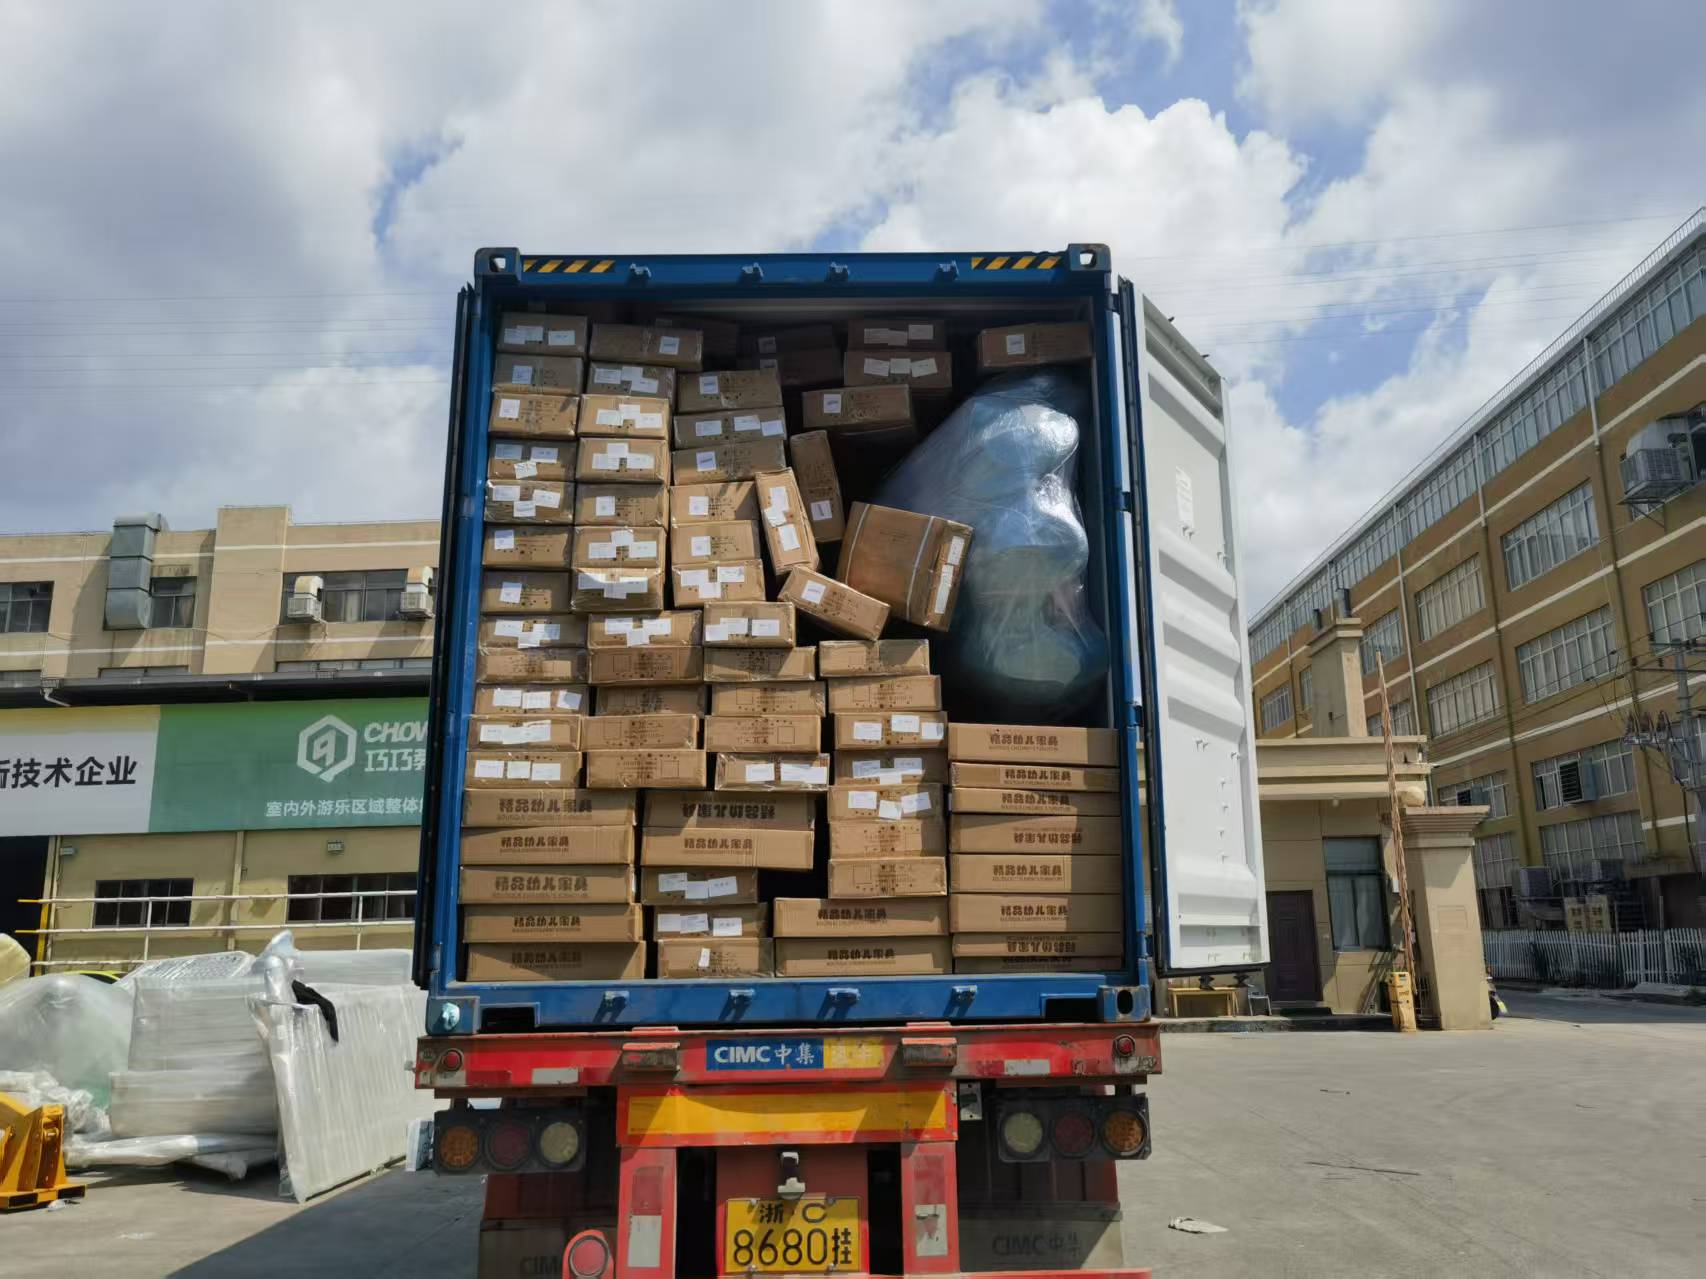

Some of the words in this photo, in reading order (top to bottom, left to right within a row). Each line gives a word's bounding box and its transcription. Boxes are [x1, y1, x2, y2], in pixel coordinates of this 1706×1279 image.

[266, 797, 423, 817] 室内外游乐区域整体
[714, 1046, 770, 1063] CIMC
[775, 1043, 814, 1065] 中集
[734, 1228, 852, 1266] 8680挂
